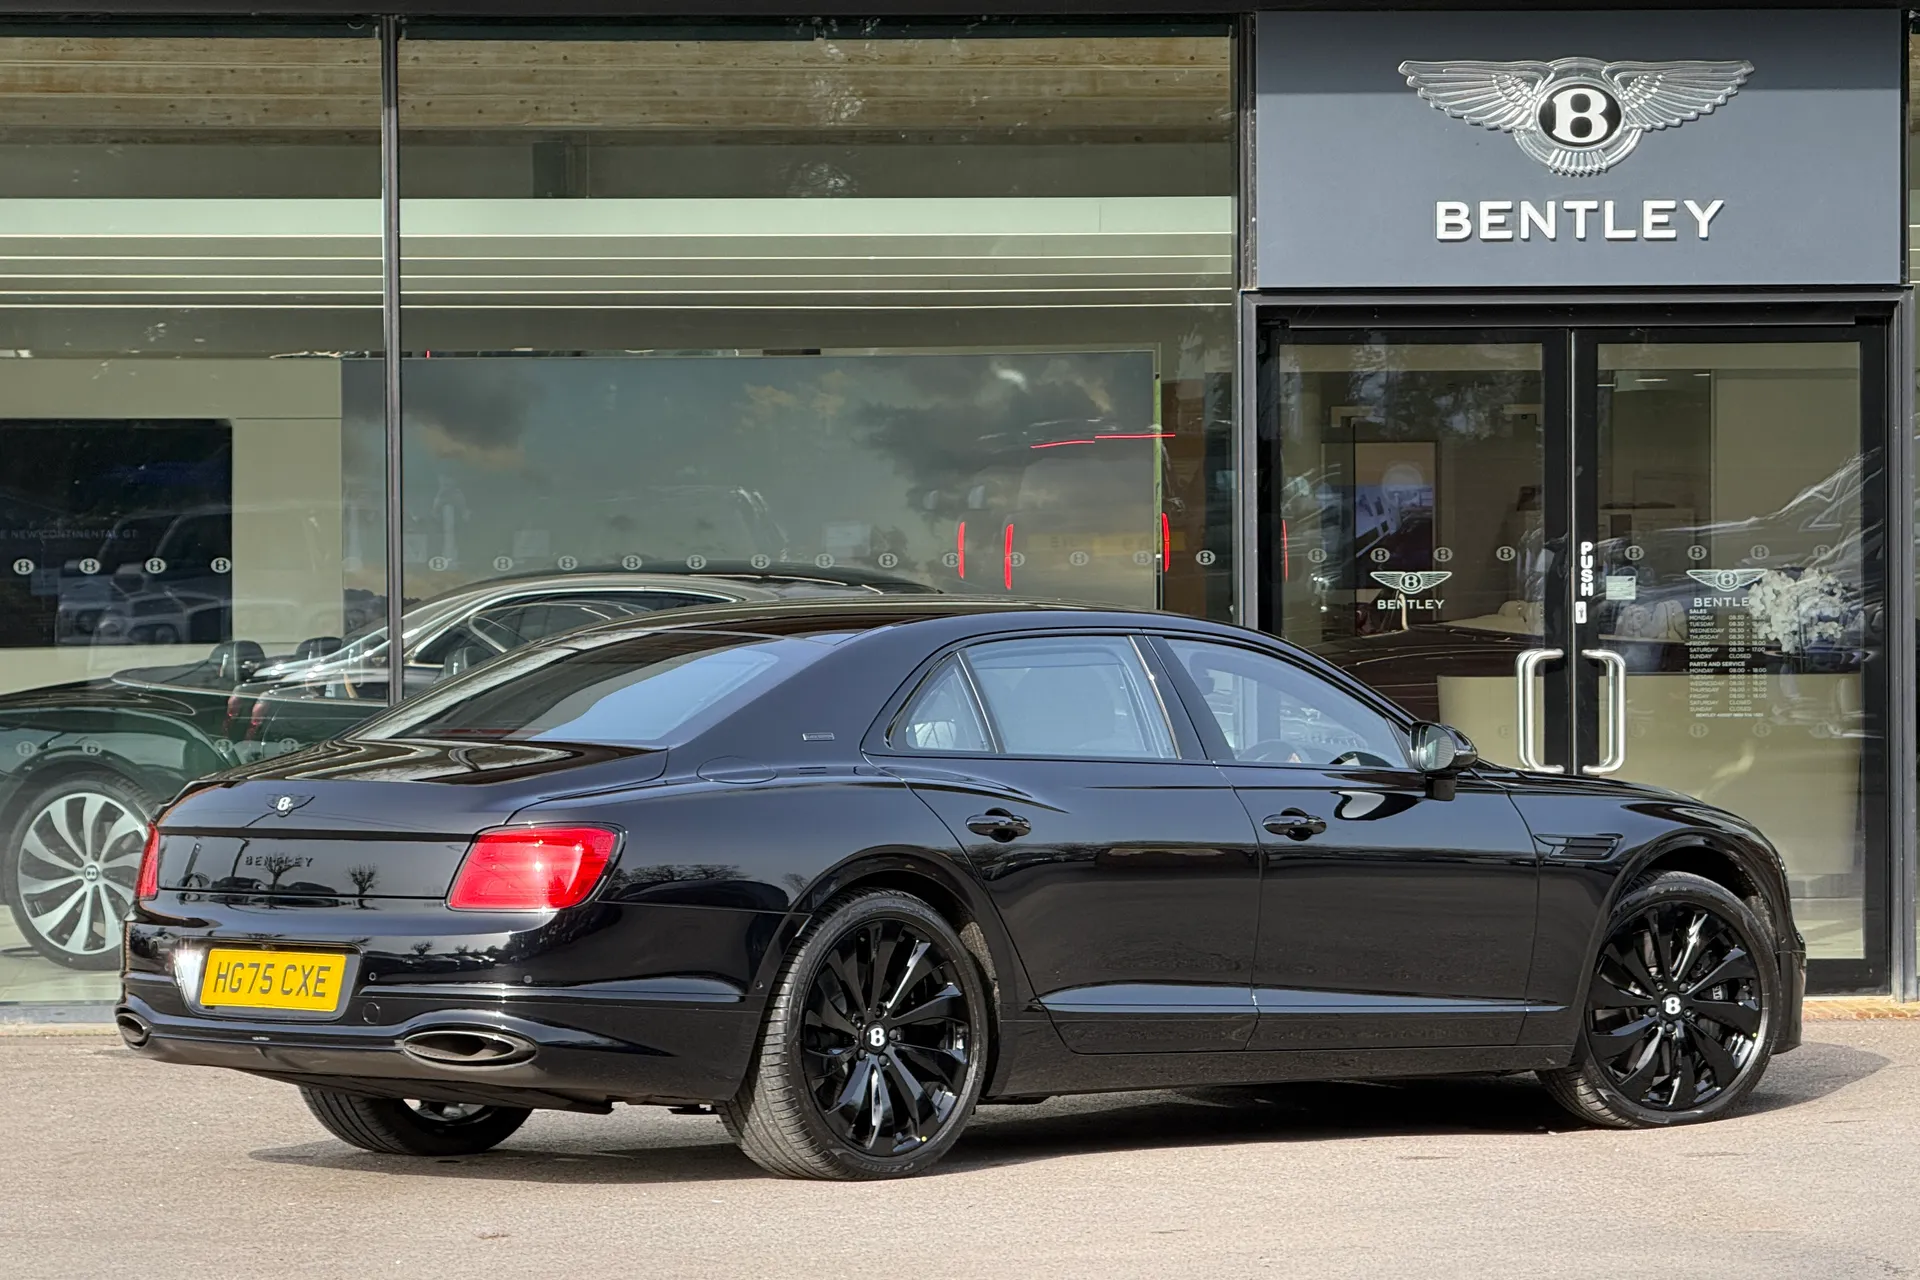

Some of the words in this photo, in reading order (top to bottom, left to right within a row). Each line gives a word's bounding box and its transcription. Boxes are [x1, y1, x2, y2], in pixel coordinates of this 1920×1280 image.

[1551, 87, 1609, 144] B
[1435, 200, 1725, 242] BENTLEY
[11, 530, 40, 539] NEW
[123, 530, 139, 539] GT
[1580, 541, 1594, 596] PUSH
[1377, 599, 1445, 609] BENTLEY
[1693, 598, 1750, 607] BENTLE
[276, 796, 292, 811] B
[213, 961, 275, 994] HG75
[281, 964, 331, 998] CXE
[1665, 996, 1682, 1014] B
[869, 1026, 886, 1047] B
